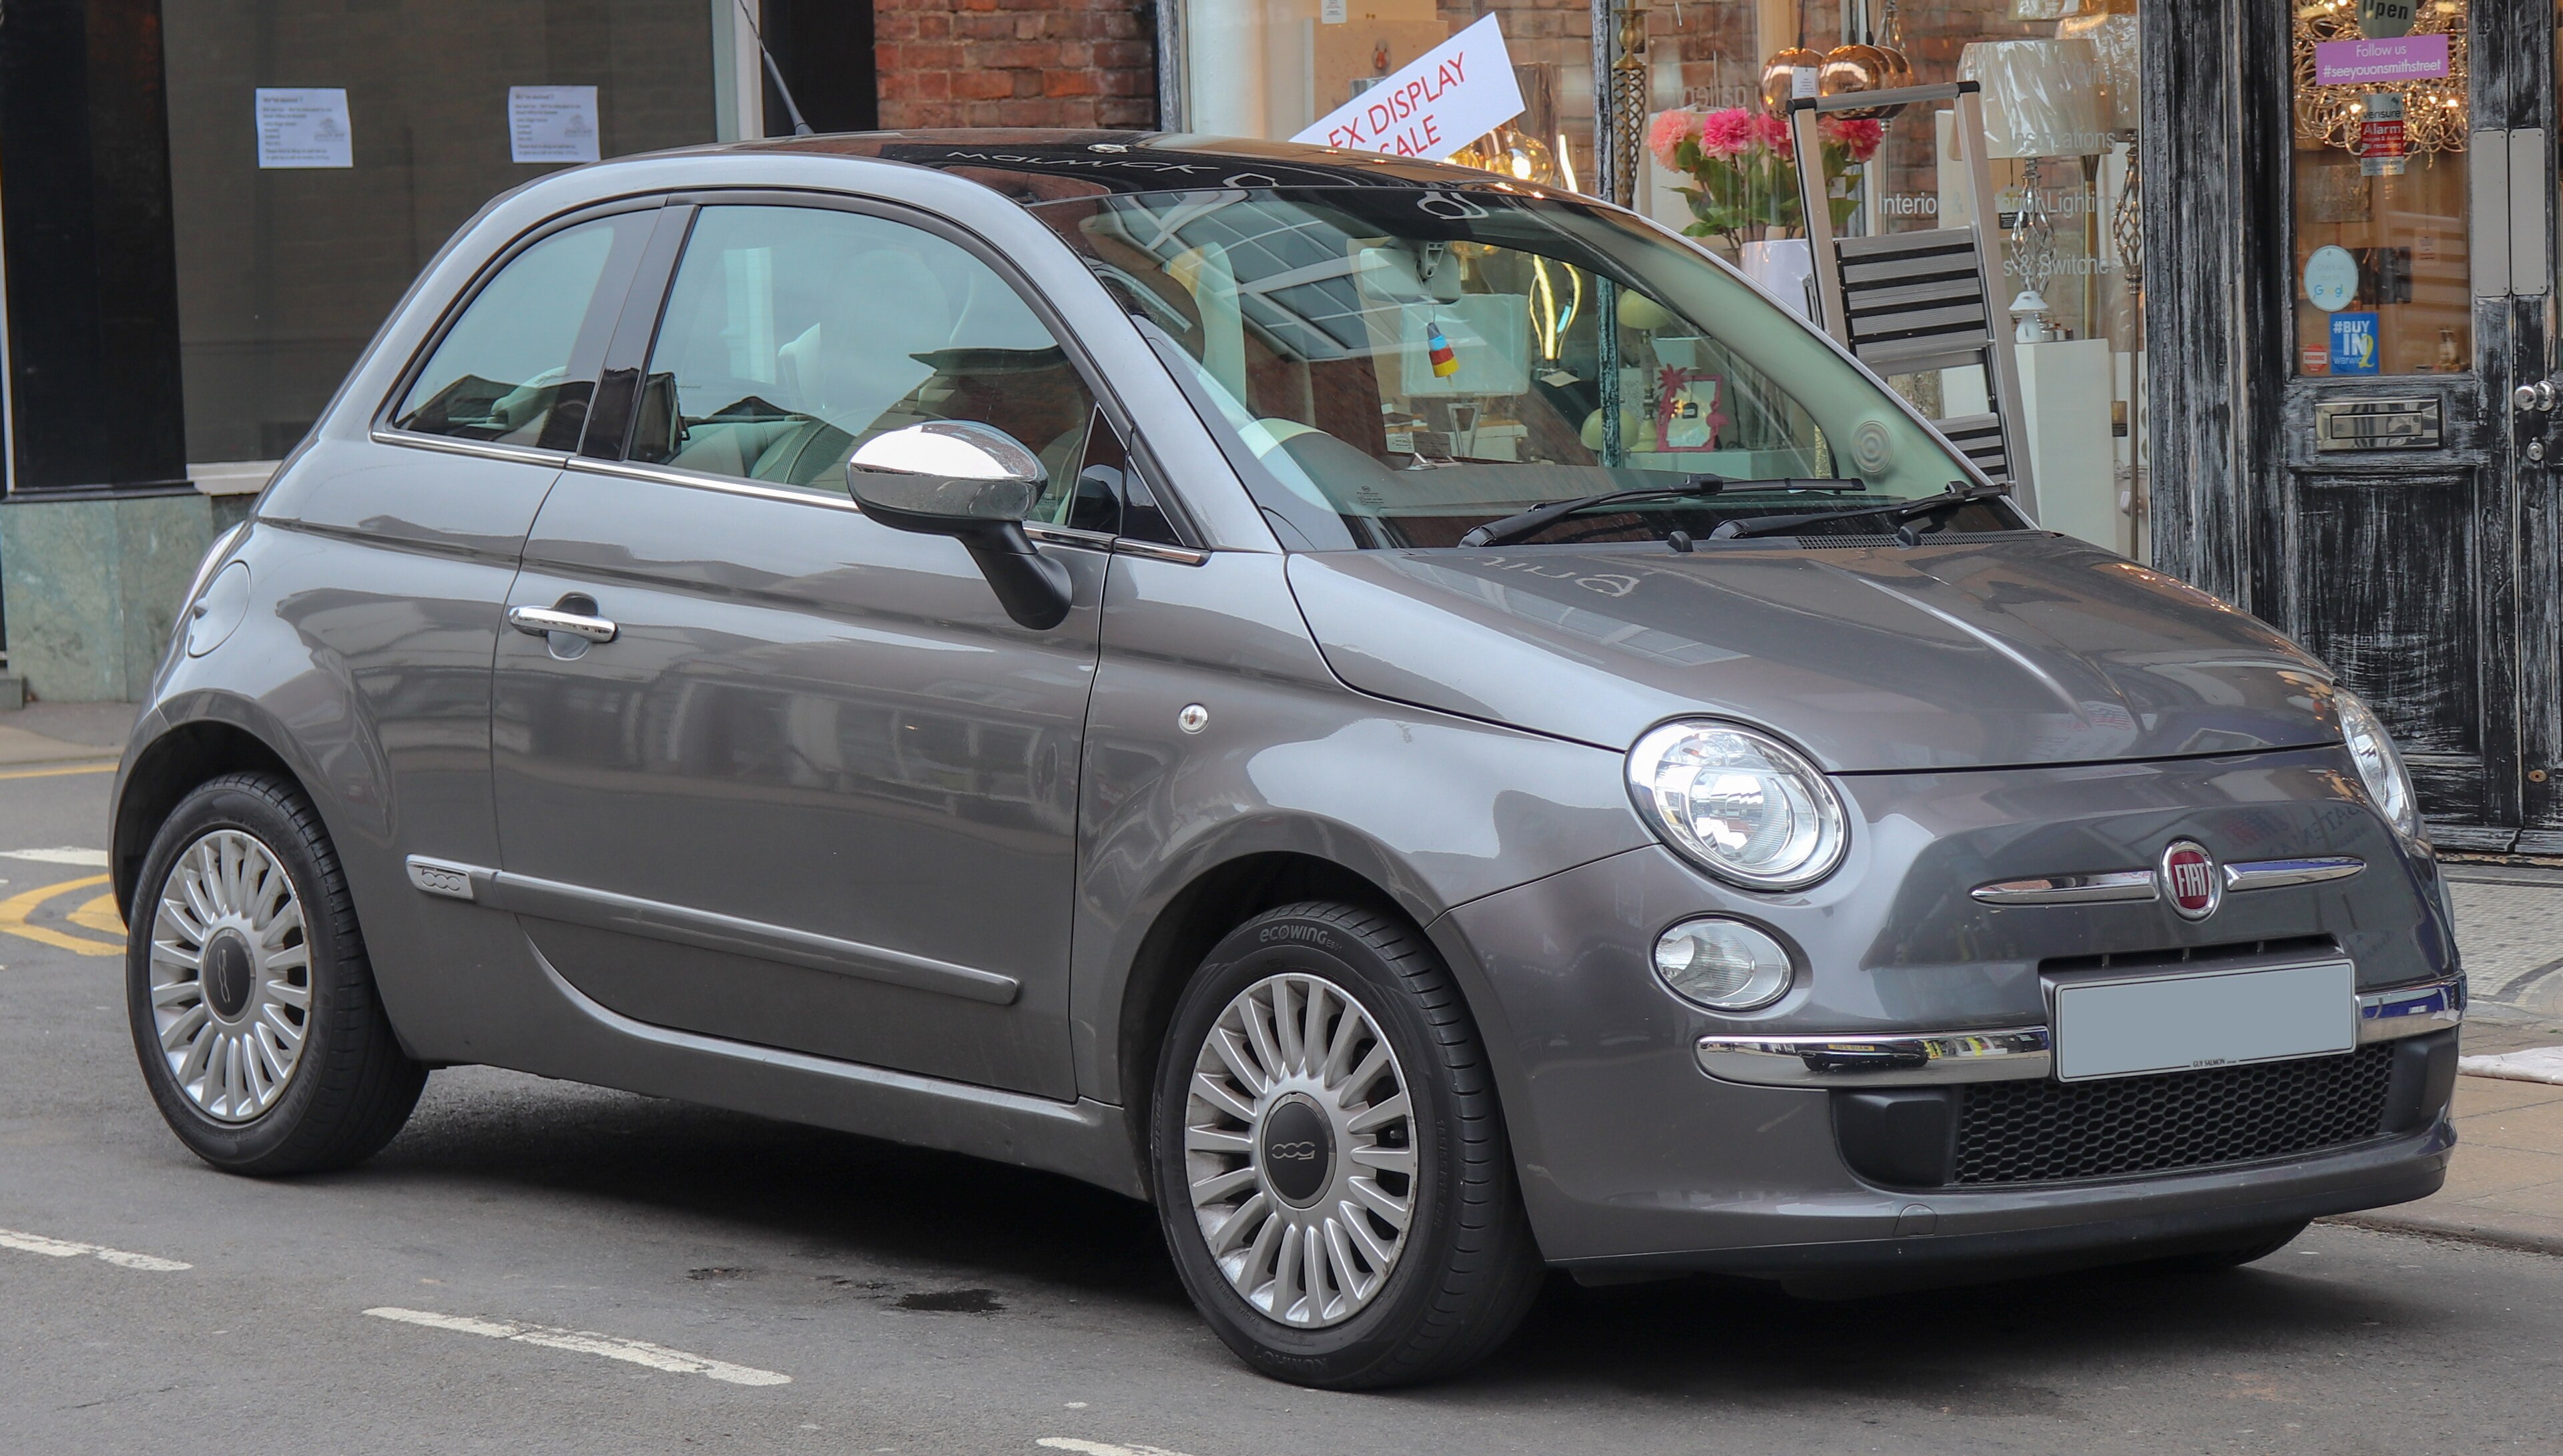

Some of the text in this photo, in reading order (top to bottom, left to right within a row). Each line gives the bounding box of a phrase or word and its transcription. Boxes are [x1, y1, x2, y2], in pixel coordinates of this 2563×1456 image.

[2356, 43, 2407, 57] Follow us
[2323, 59, 2442, 81] #seeyouonsmithstreet
[1367, 51, 1465, 135] DISPLAY
[1379, 114, 1442, 157] ALE
[2363, 123, 2401, 135] Alarm
[1878, 192, 1938, 215] Interio
[2314, 284, 2348, 298] Gogl
[2333, 320, 2370, 334] #BUY
[2333, 356, 2363, 366] warwi
[2174, 862, 2207, 898] FIAT
[2204, 1058, 2225, 1066] SALMON
